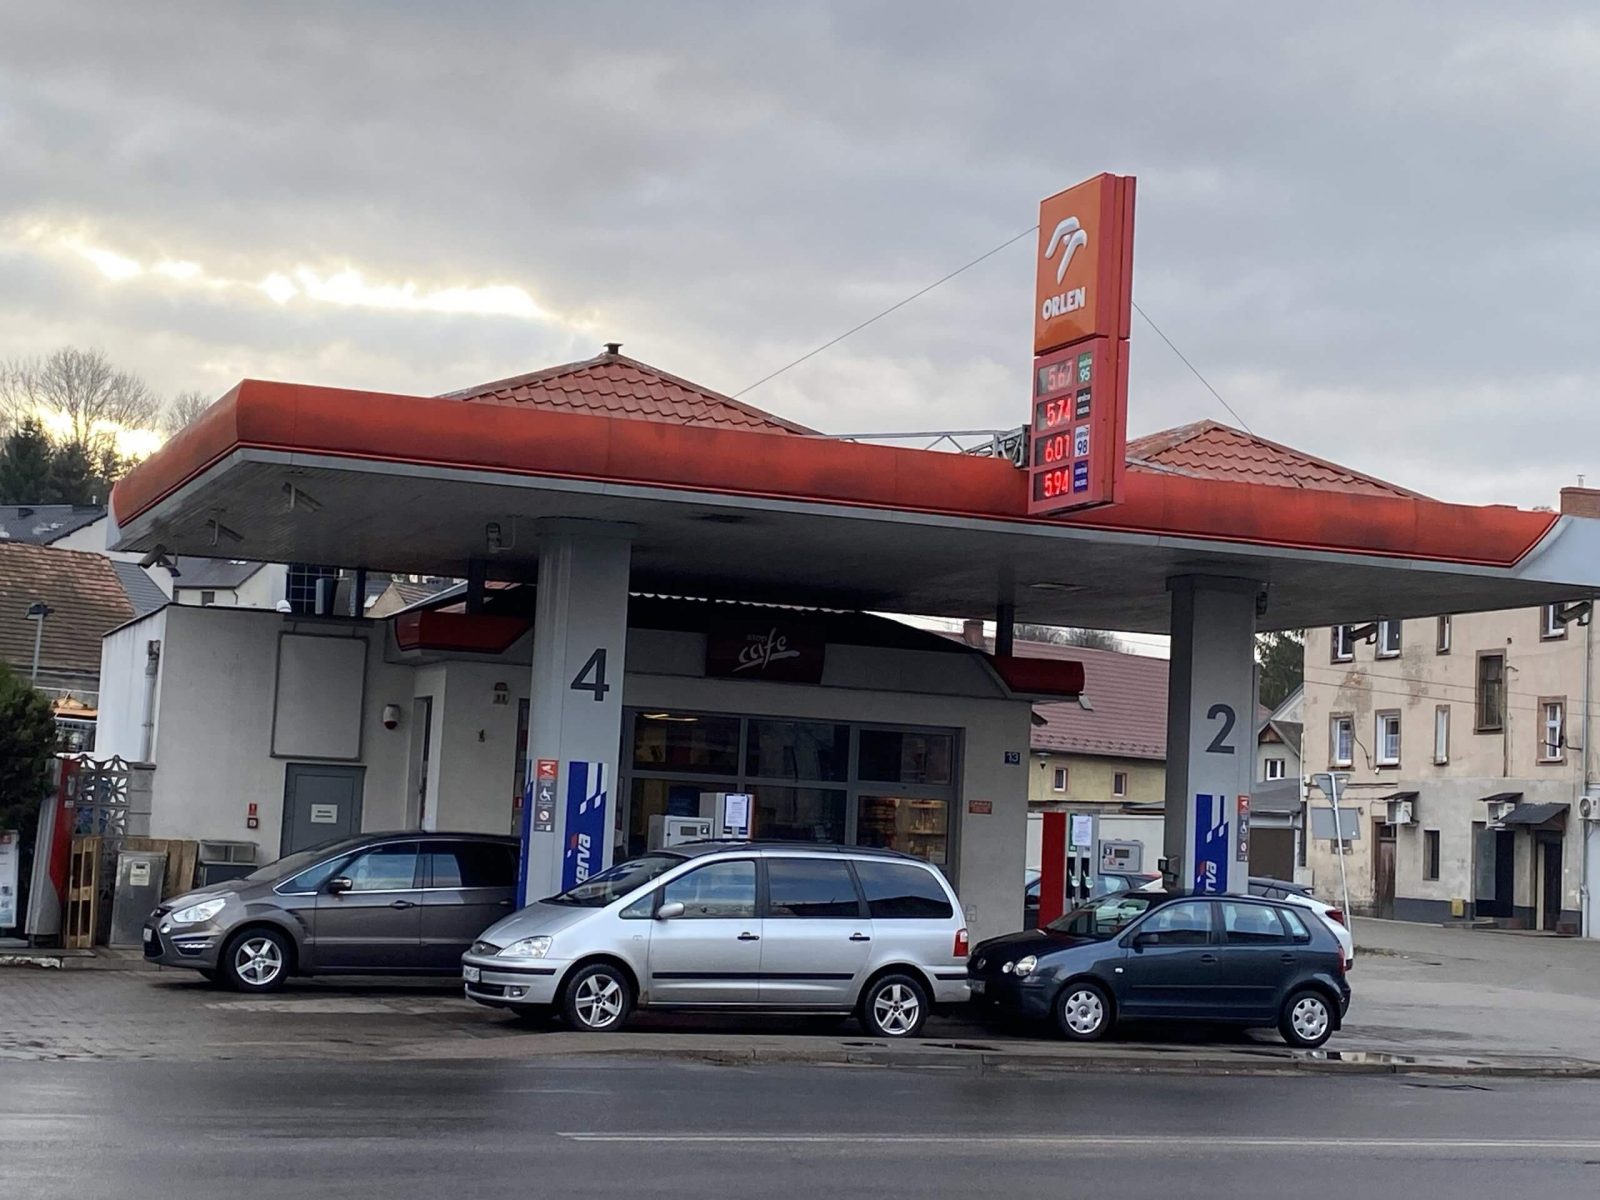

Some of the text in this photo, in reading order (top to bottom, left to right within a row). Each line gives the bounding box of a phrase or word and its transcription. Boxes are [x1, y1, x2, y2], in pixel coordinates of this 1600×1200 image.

[1042, 286, 1086, 320] ORLEN
[1079, 366, 1090, 383] 95
[1077, 439, 1088, 455] 98
[1044, 469, 1069, 497] 5.94
[570, 648, 609, 701] 4
[1206, 703, 1236, 754] 2
[1206, 860, 1217, 892] rva
